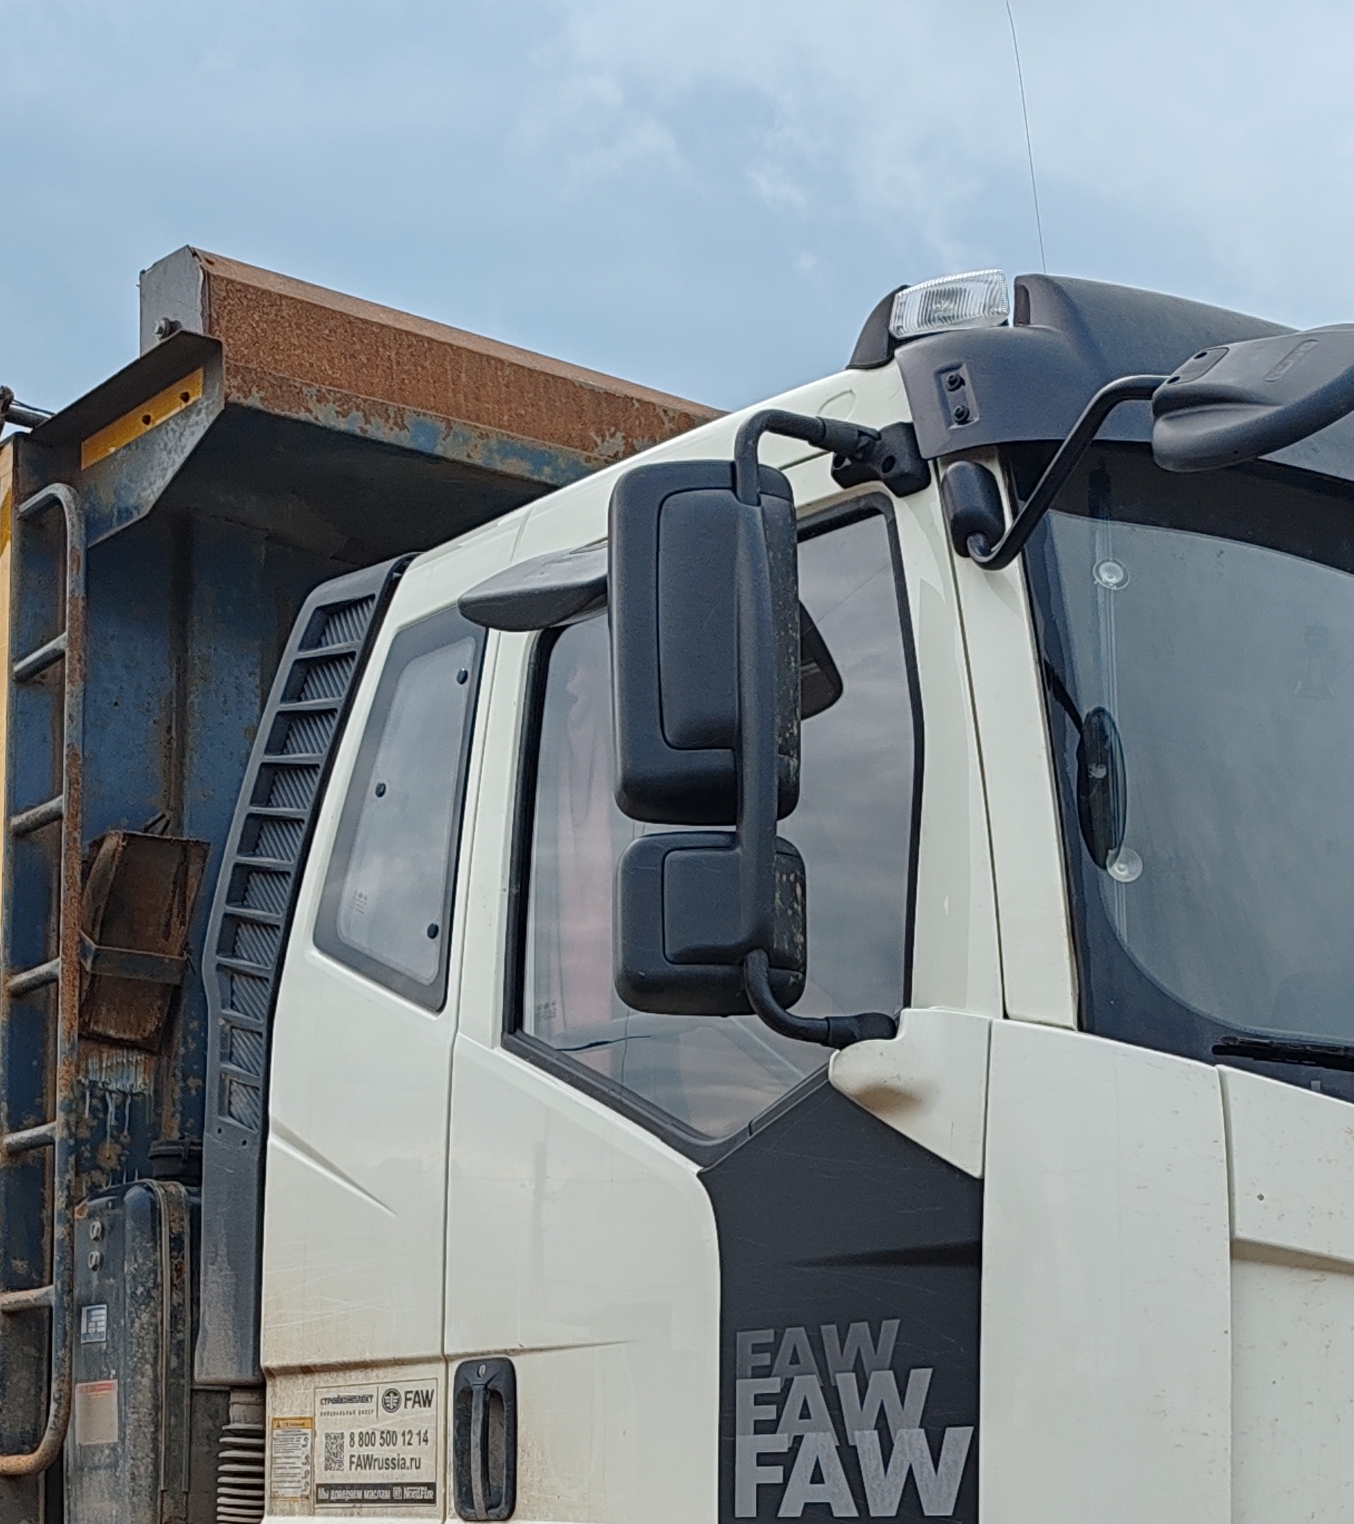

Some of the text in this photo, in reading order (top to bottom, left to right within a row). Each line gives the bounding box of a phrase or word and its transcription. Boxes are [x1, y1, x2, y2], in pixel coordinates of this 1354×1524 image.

[736, 1319, 900, 1386] FAW
[404, 1389, 434, 1409] FAW
[736, 1367, 934, 1446] FAW
[349, 1429, 429, 1448] 8 800 500 12 14
[349, 1453, 421, 1471] FAWrussia.ru
[734, 1425, 974, 1518] FAW
